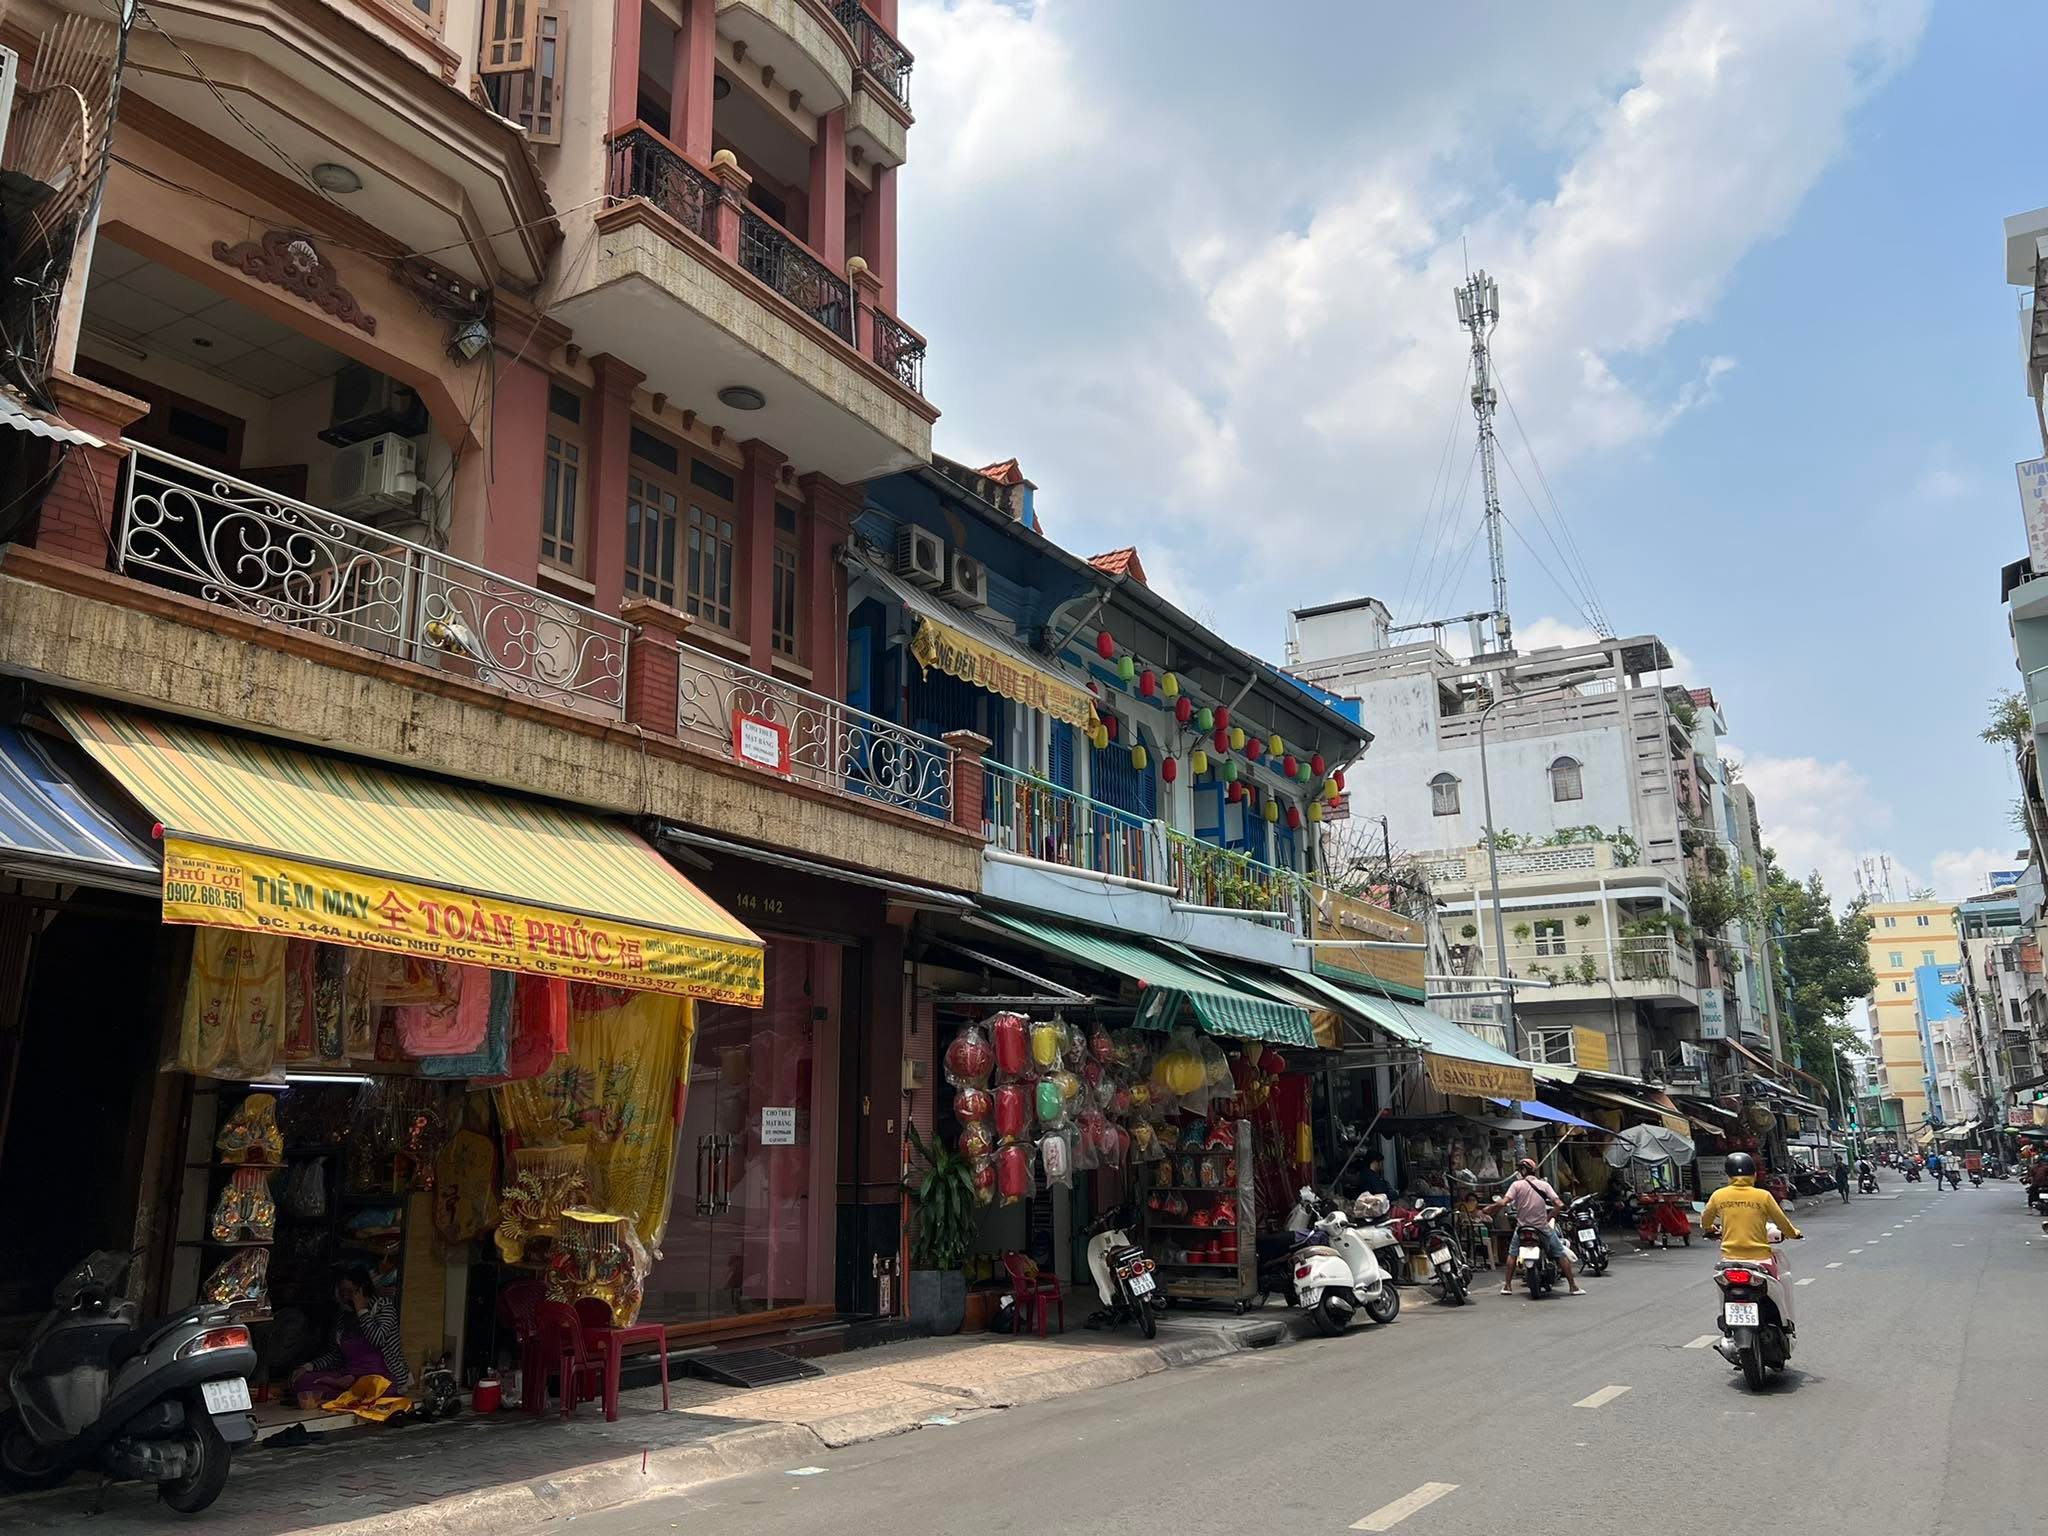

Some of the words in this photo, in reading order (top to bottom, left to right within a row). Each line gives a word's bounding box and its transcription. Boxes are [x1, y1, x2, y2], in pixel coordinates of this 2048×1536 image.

[167, 864, 205, 881] PHÚ
[212, 873, 241, 889] LỢI
[166, 881, 243, 910] 0902.668.551
[737, 893, 757, 909] 144
[763, 898, 783, 913] 142
[252, 873, 315, 912] TIỆM
[322, 887, 370, 920] MAY
[373, 890, 413, 934] 全
[418, 899, 515, 950] TOÀN
[525, 918, 612, 964] PHÚC
[616, 936, 643, 971] 福
[258, 915, 290, 929] ĐC:
[297, 921, 342, 937] 144A
[346, 929, 402, 946] LƯƠNG
[445, 945, 477, 958] HỌC
[491, 953, 521, 965] P.11
[535, 960, 557, 971] Q.5
[596, 970, 678, 989] 0908.133.527
